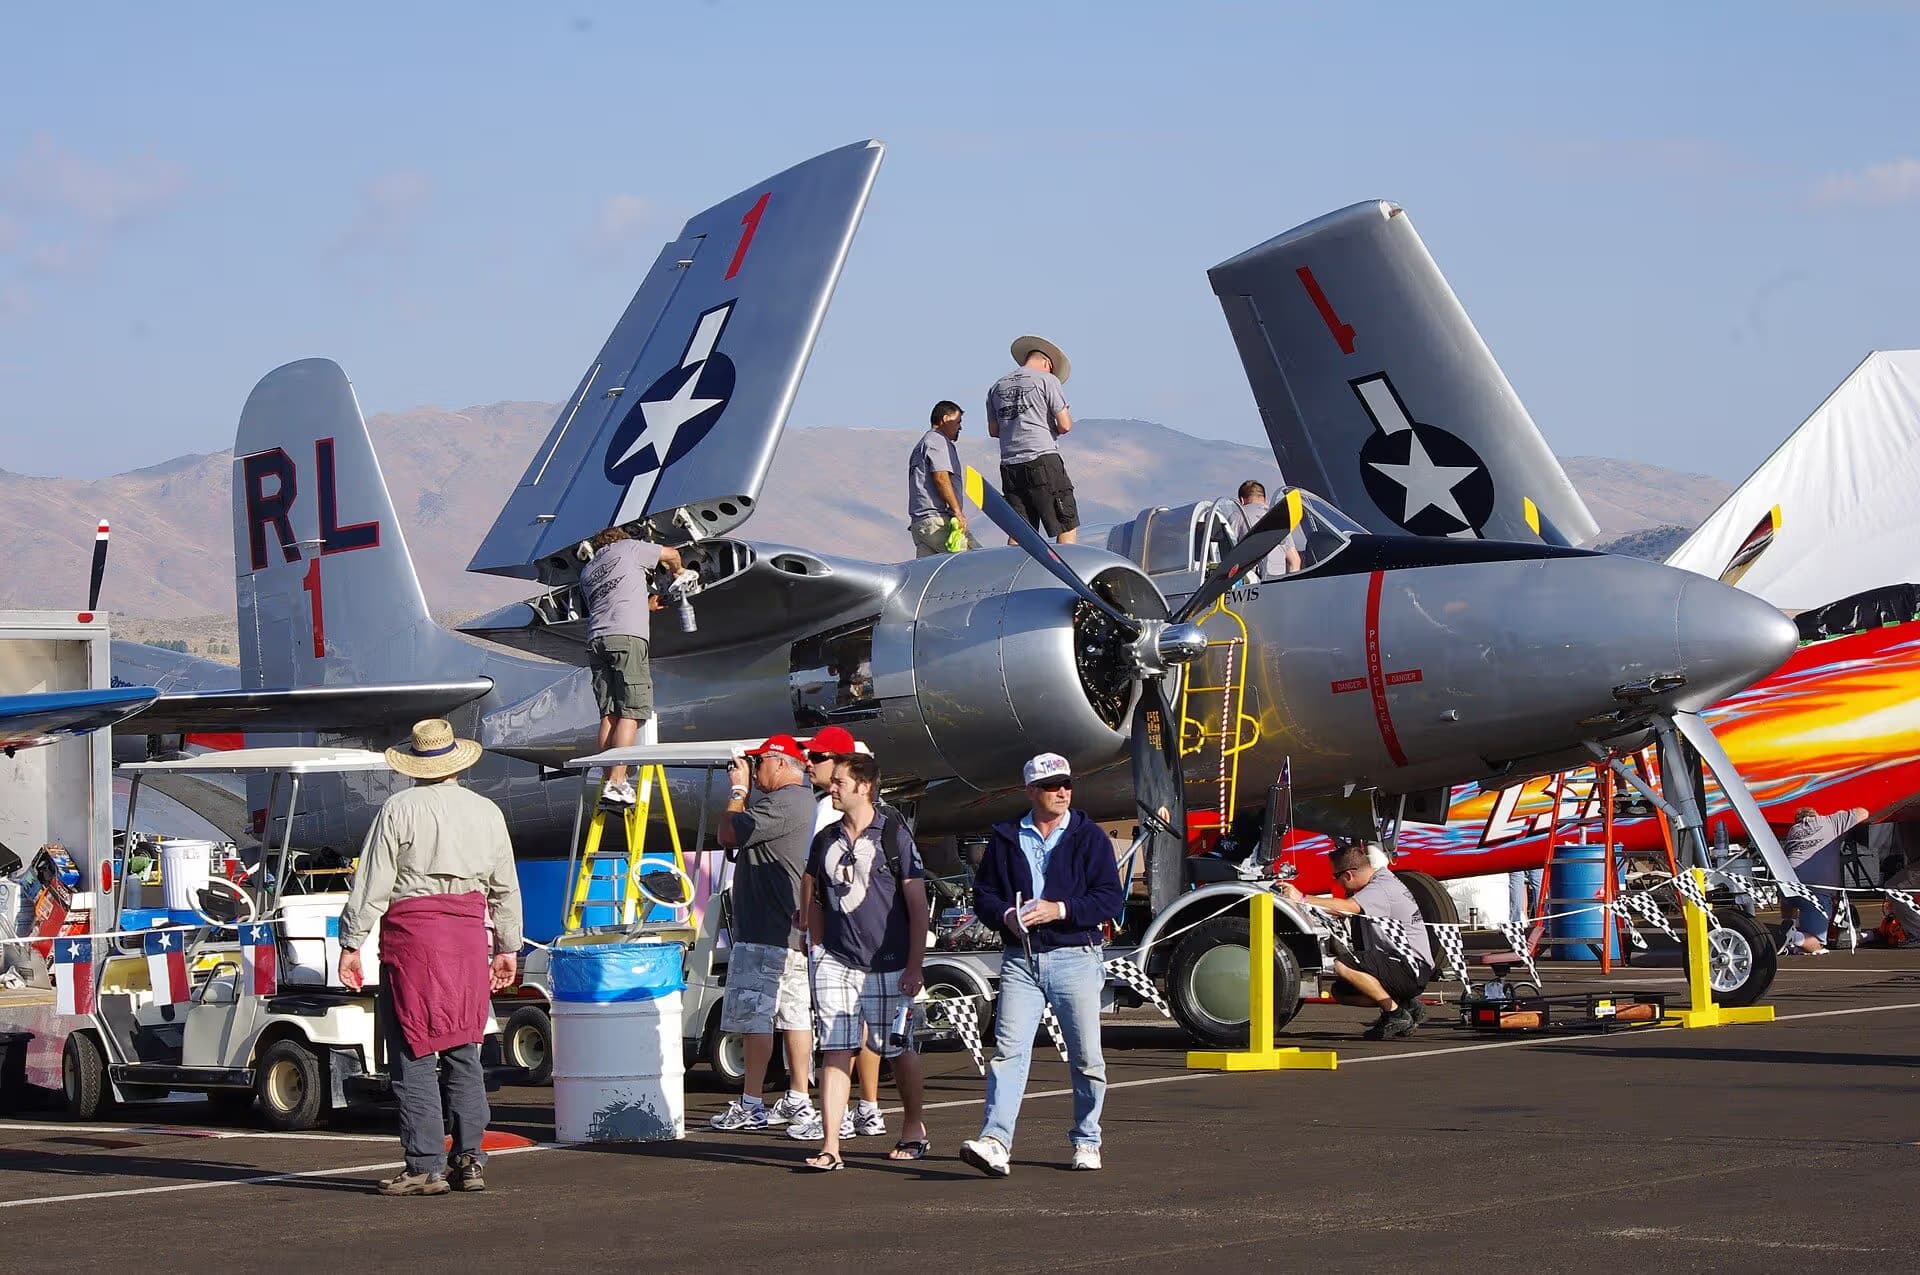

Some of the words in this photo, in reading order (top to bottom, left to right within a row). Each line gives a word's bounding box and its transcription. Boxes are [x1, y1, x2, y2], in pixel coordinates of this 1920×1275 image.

[723, 191, 772, 281] 1
[243, 437, 380, 571] RL
[303, 557, 325, 658] 1
[1222, 587, 1260, 605] EWIS
[1337, 680, 1362, 691] DANGER
[1369, 629, 1391, 735] PROPELLER
[1391, 672, 1417, 683] DANGER
